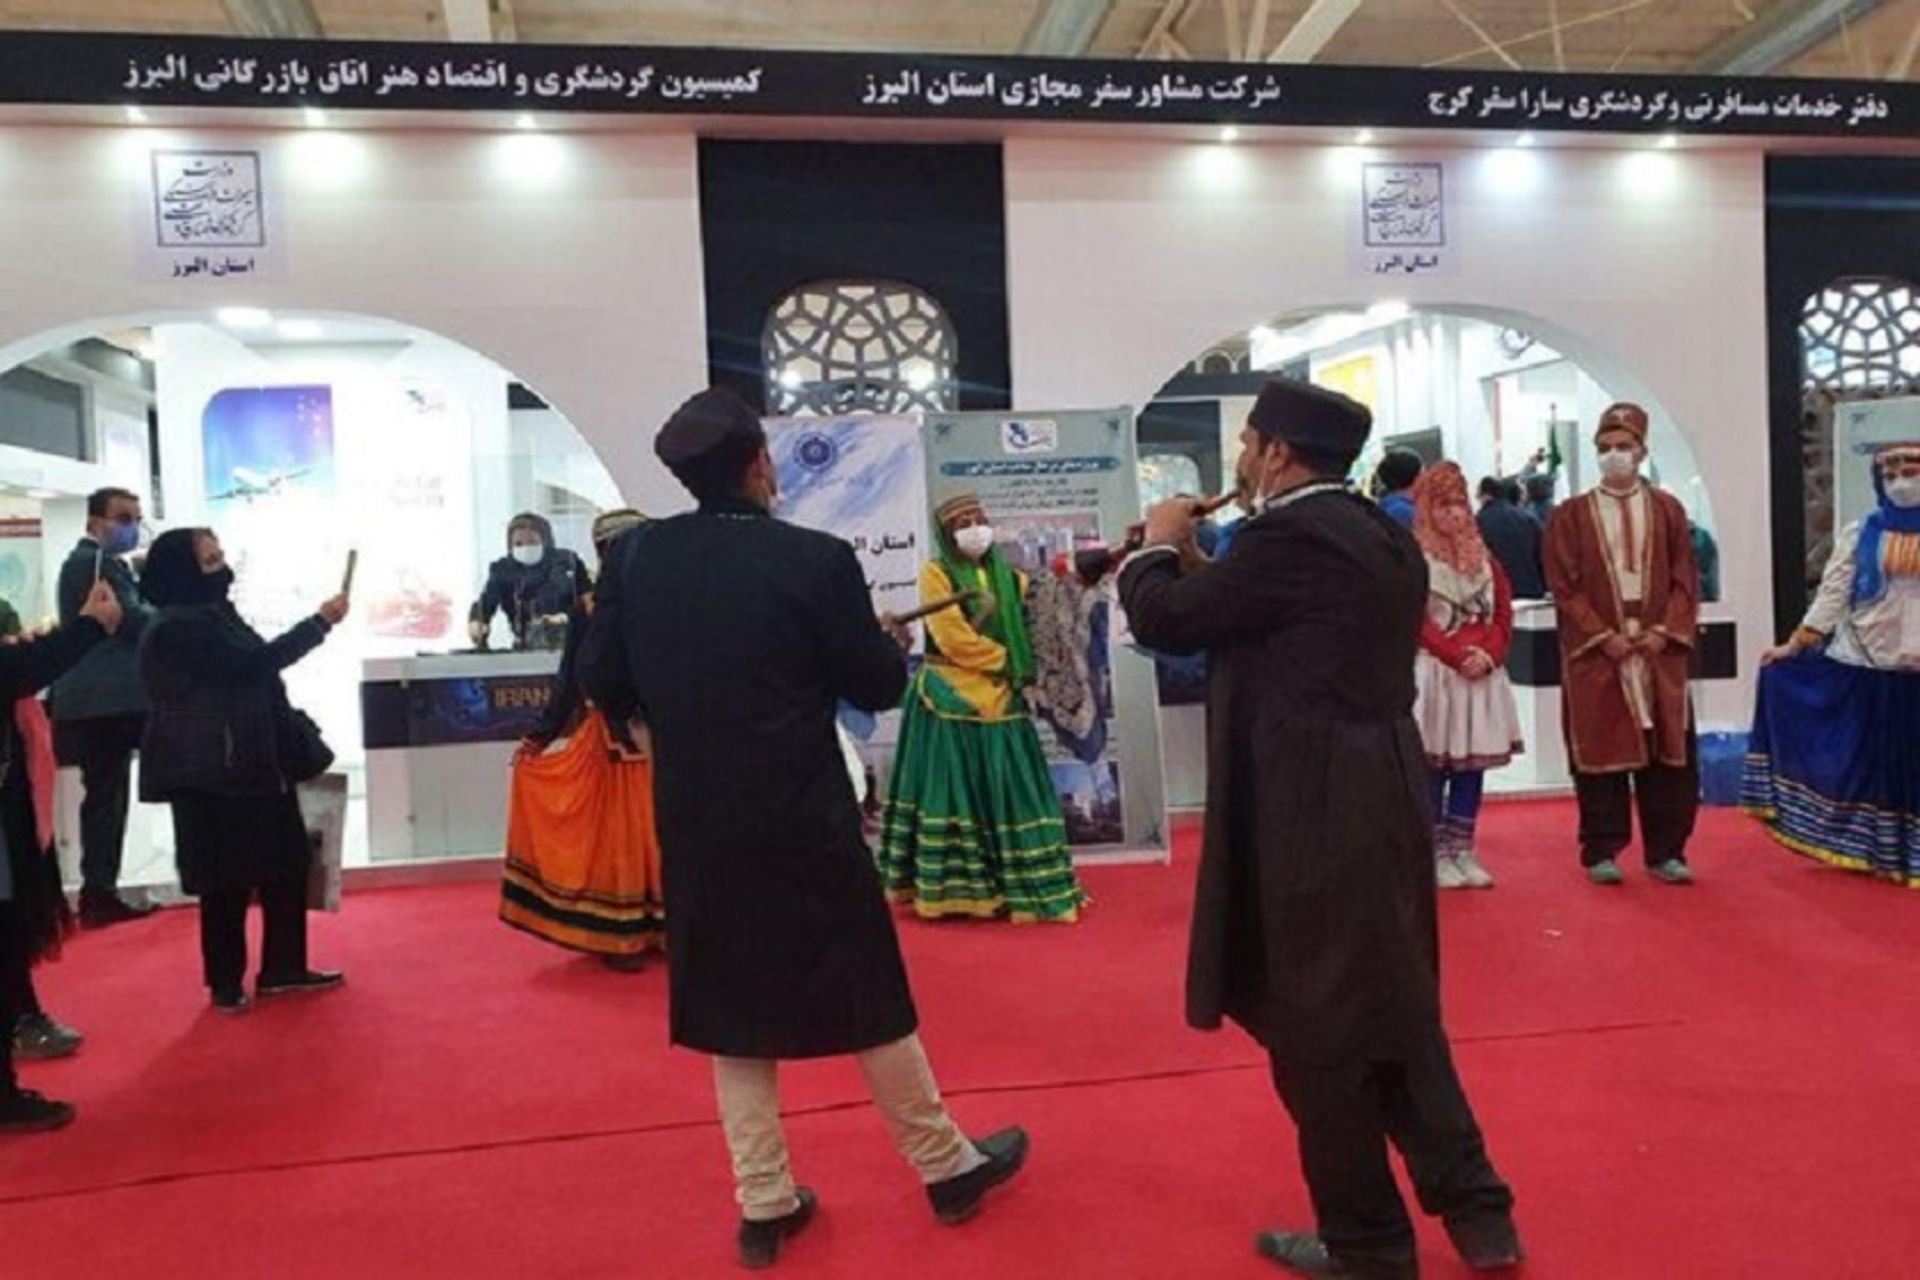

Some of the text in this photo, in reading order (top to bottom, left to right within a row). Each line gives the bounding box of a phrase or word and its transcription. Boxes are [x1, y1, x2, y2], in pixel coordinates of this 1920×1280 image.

[123, 53, 187, 89] البرز
[318, 59, 368, 94] اتاق
[375, 64, 419, 95] هنر
[425, 59, 507, 88] اقتصاد
[514, 72, 528, 96] و
[534, 64, 654, 98] گردشگری
[660, 67, 762, 99] کمیسیون
[862, 69, 1281, 108] شرکت مشاور سفر مجازی استان البرز
[1477, 86, 1517, 117] سفر
[1519, 86, 1565, 118] سارا
[1683, 88, 1770, 123] مسافرتی
[1773, 93, 1843, 117] خدمات
[1847, 93, 1889, 125] دفتر
[172, 255, 255, 277] استان البرز
[1404, 254, 1439, 273] استان
[870, 531, 916, 556] استان
